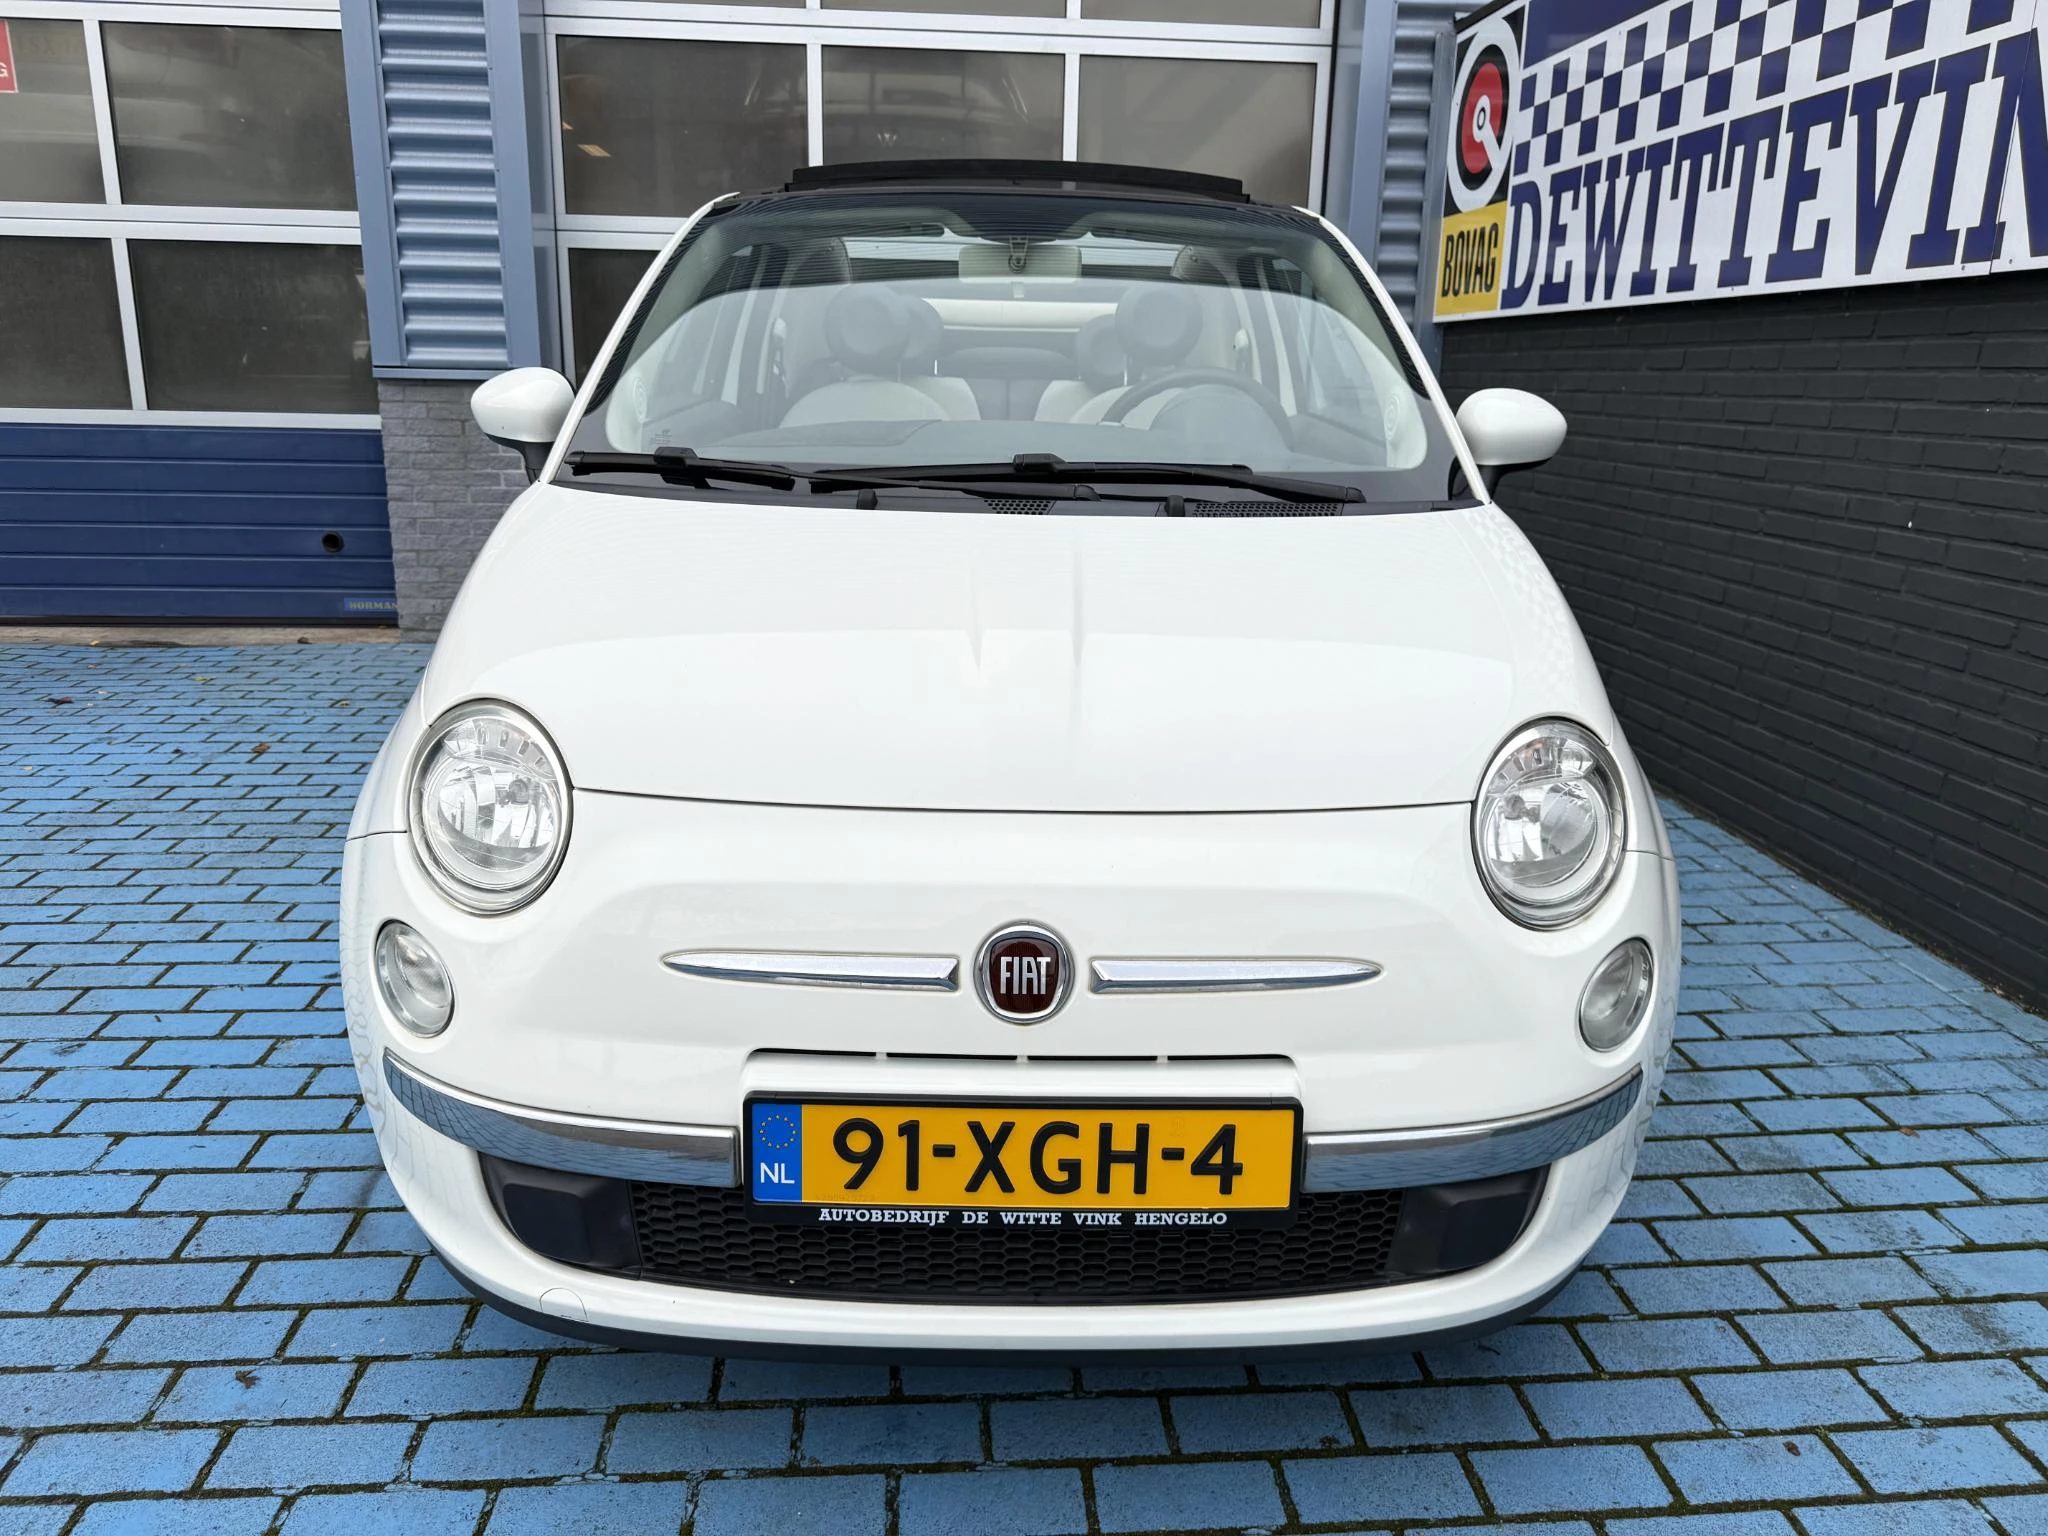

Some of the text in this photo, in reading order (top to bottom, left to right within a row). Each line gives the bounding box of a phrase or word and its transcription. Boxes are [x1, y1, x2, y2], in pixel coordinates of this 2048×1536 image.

[1441, 222, 1499, 297] BOVAG
[1000, 956, 1051, 995] FIAT
[760, 1162, 795, 1184] NL
[833, 1117, 1243, 1195] 91-XGH-4
[818, 1208, 1228, 1226] AUTOBEDRIJF DE WITTE VINK HENGELO
